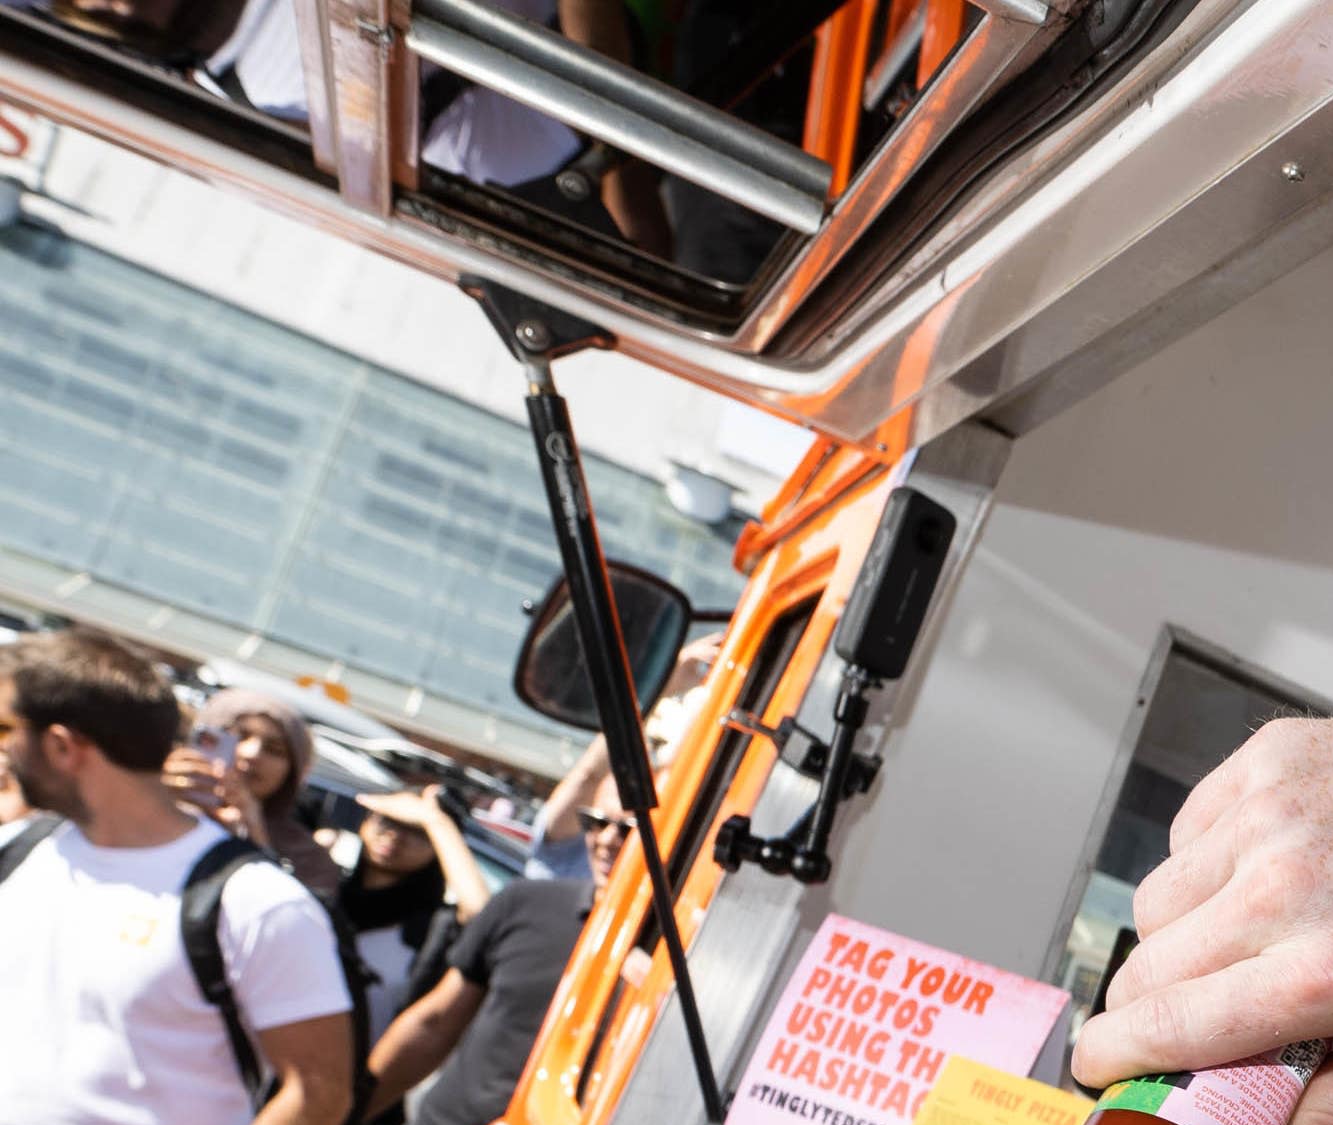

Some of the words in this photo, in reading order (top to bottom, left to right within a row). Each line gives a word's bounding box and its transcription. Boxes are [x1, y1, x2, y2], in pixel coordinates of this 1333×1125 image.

[803, 966, 940, 1037] PHOTOS
[823, 933, 895, 979] TAG
[900, 956, 994, 1016] YOUR
[786, 1003, 891, 1064] USING
[897, 1040, 945, 1083] TH
[971, 1079, 1024, 1112] TINGLY
